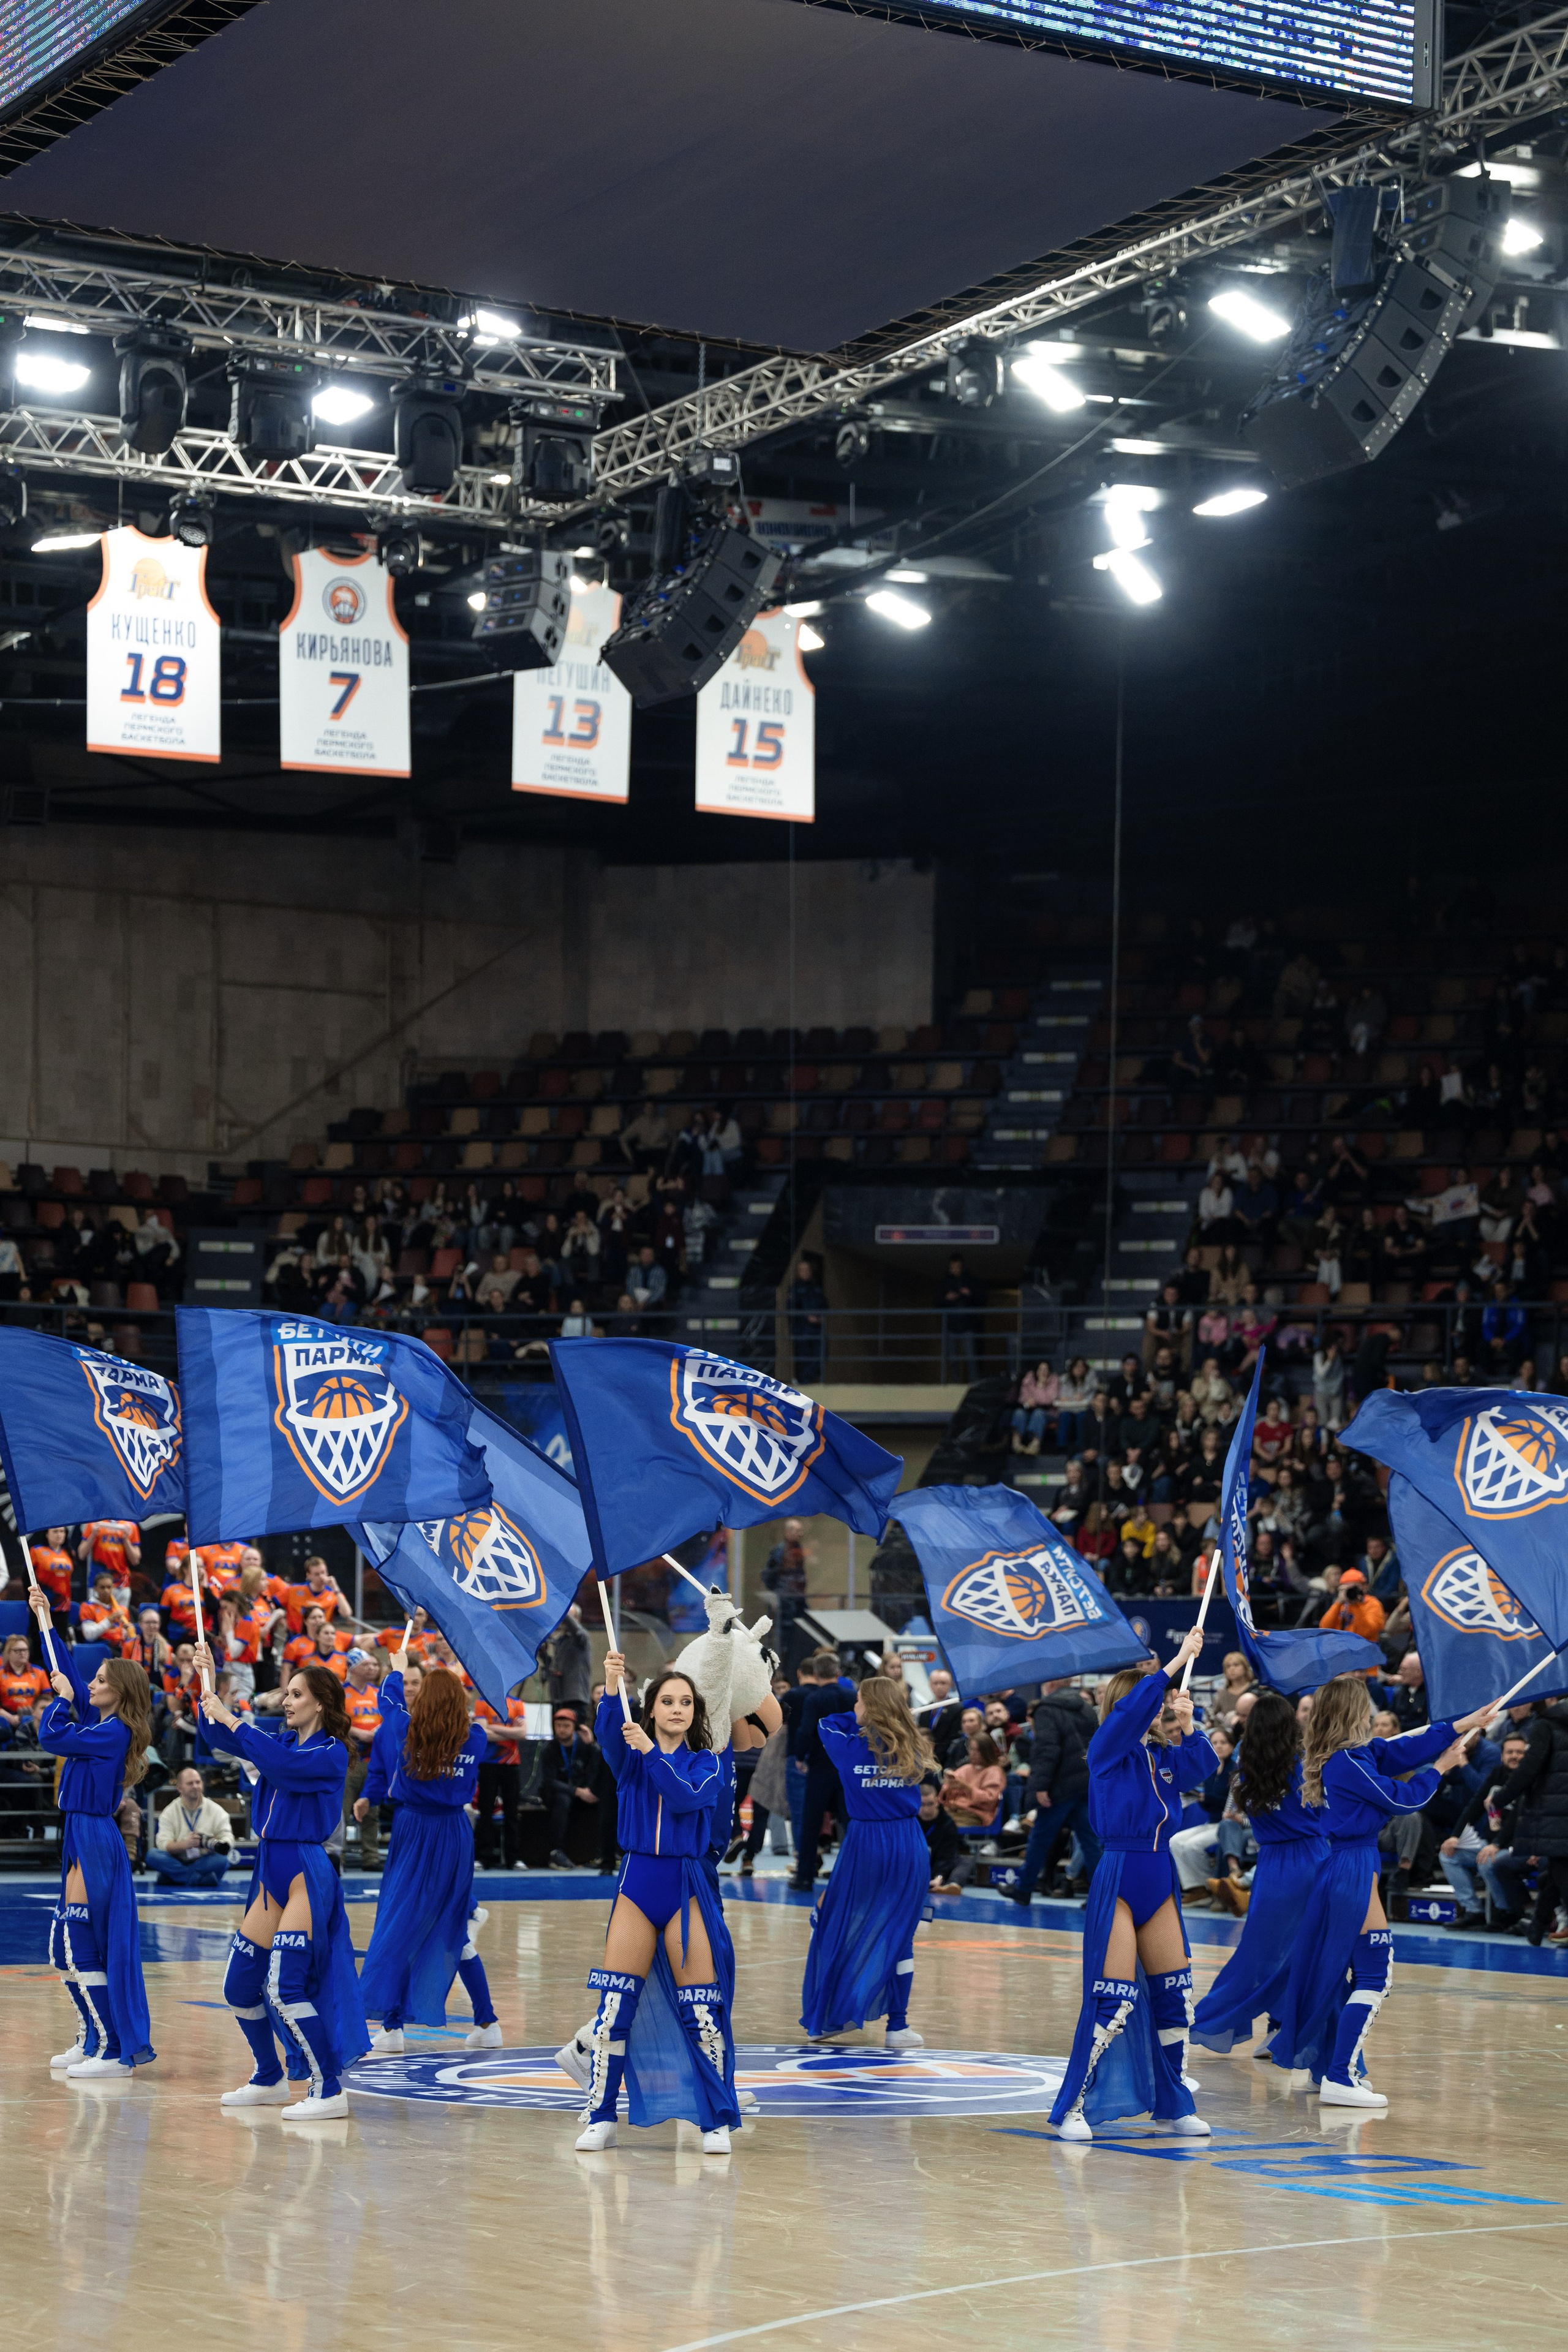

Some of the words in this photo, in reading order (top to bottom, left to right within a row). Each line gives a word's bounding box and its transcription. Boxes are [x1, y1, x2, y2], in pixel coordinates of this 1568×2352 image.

[112, 614, 195, 648] КУЩЕНКО
[297, 632, 393, 667] КИРЬЯНОВА
[120, 652, 187, 707] 18
[329, 671, 361, 721] 7
[720, 678, 793, 715] ДАЙНЕКО
[541, 695, 602, 750] 13
[726, 718, 785, 771] 15
[294, 1347, 375, 1366] ПАРМ
[7, 1687, 36, 1697] FAN
[861, 1778, 905, 1788] ПАРМА
[273, 1934, 306, 1947] RMA
[589, 1972, 635, 1992] PARMA
[1093, 1980, 1139, 2000] PARM
[1164, 1972, 1193, 1989] PAR
[677, 1988, 723, 2003] PARMA
